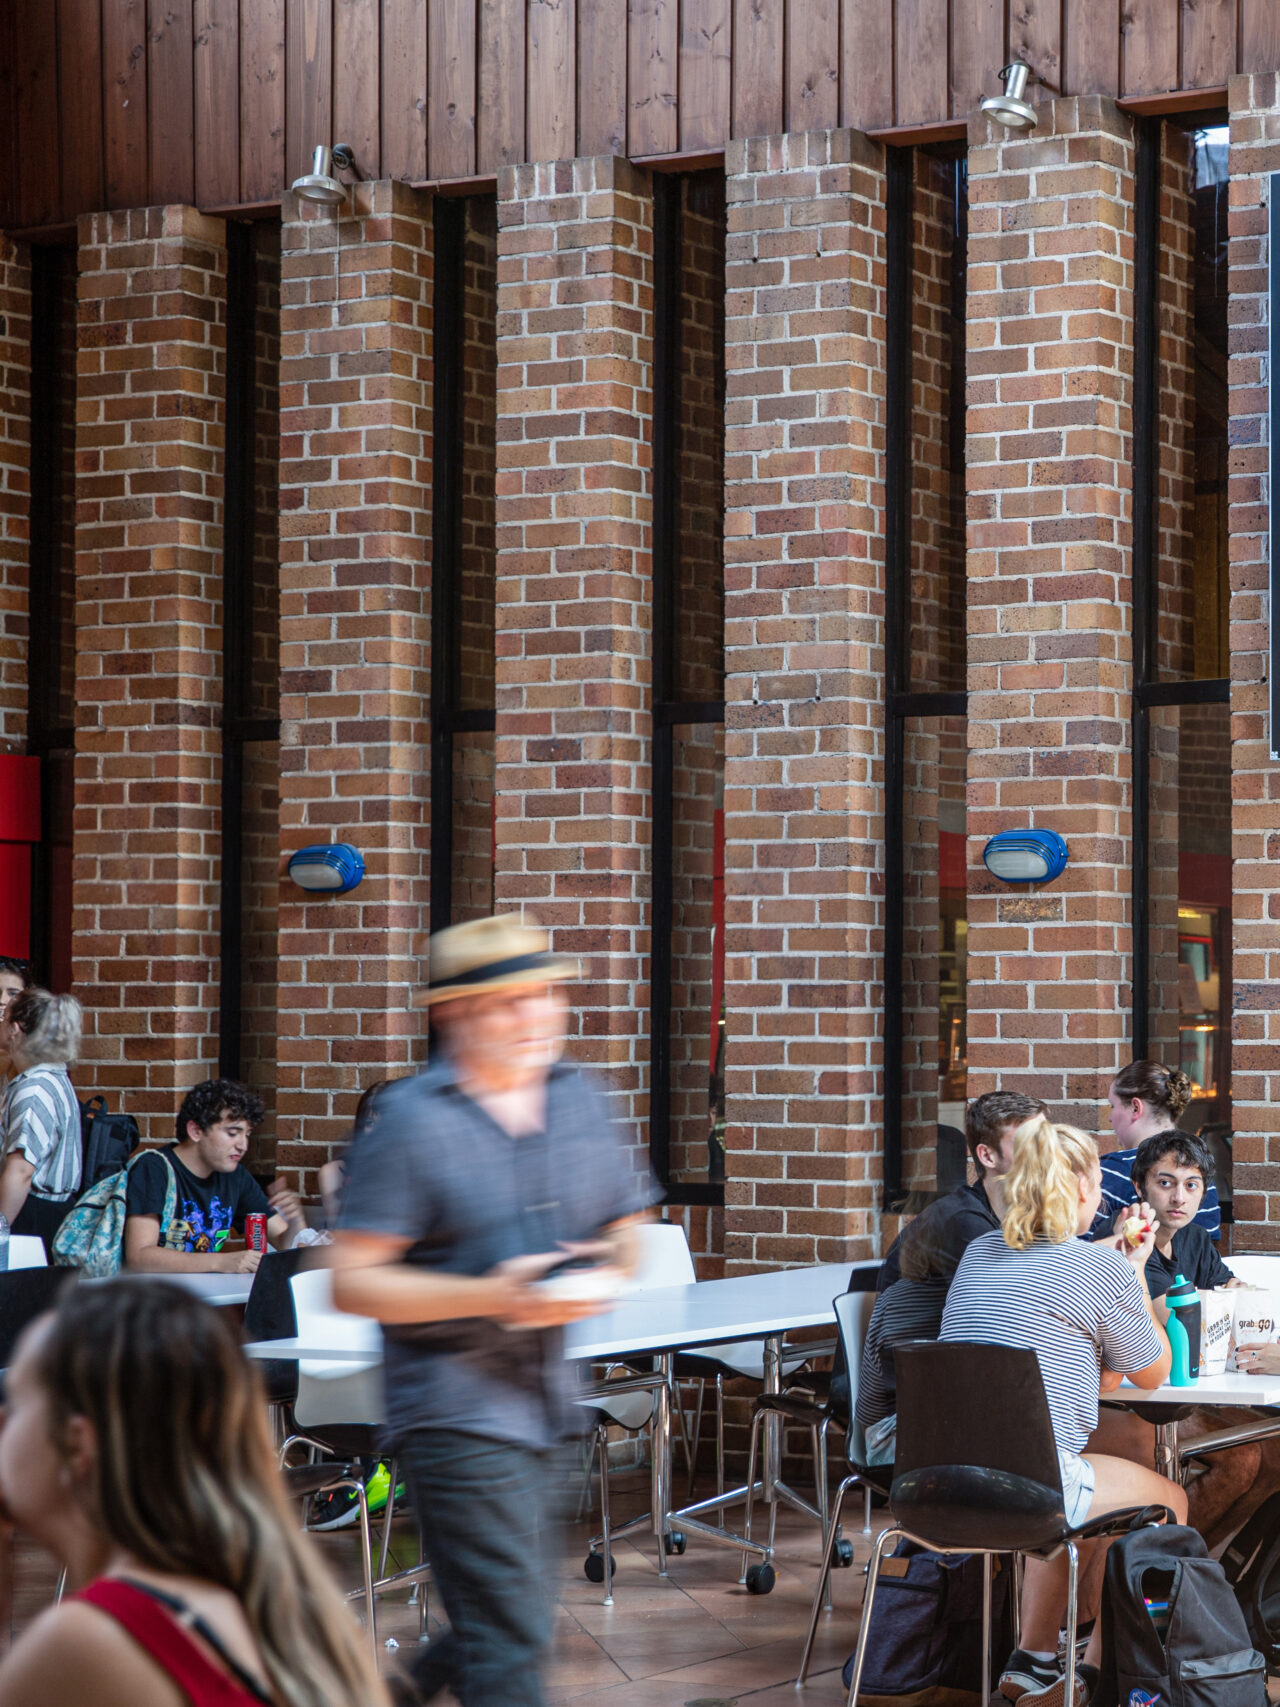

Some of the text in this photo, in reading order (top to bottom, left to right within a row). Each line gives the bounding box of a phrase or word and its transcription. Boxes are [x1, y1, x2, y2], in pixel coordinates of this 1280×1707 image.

[252, 1222, 262, 1251] other
[1239, 1319, 1254, 1329] grab
[1258, 1319, 1271, 1333] go
